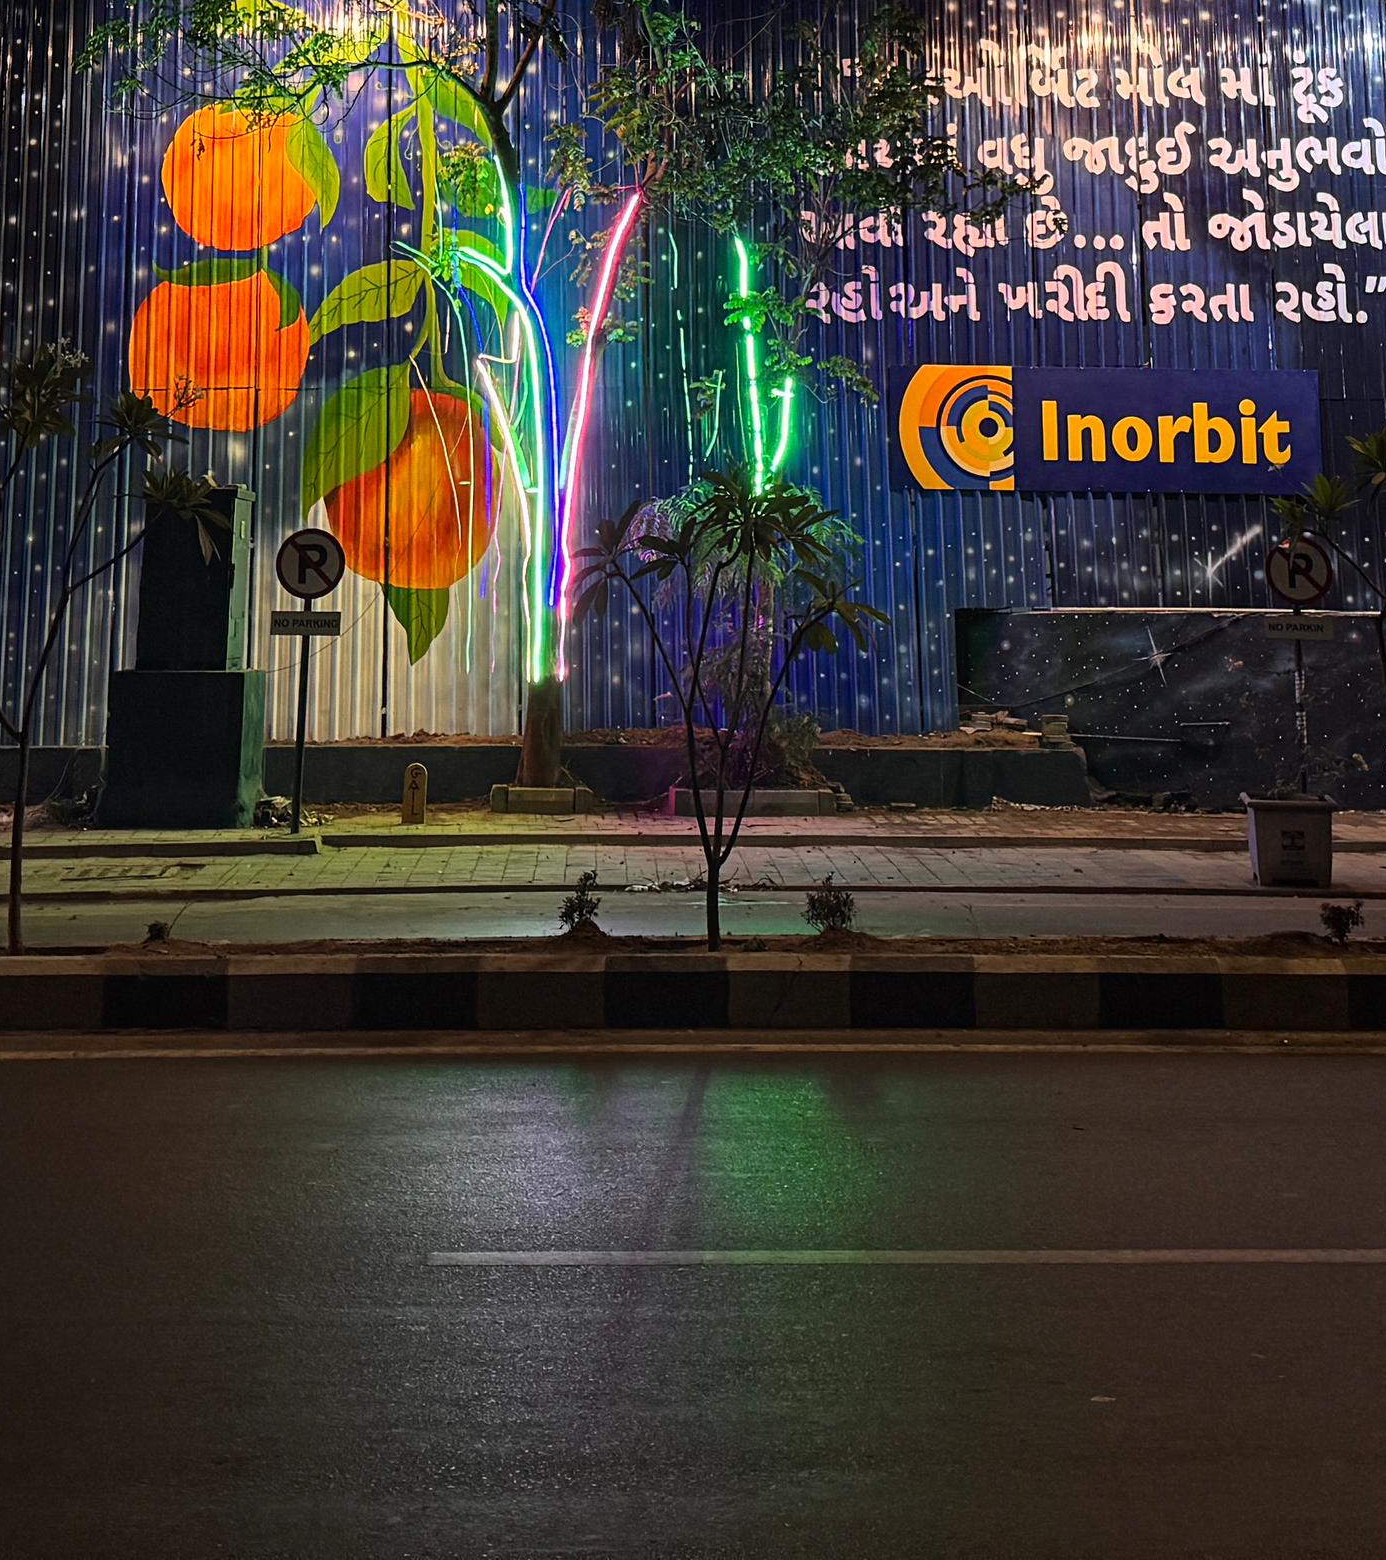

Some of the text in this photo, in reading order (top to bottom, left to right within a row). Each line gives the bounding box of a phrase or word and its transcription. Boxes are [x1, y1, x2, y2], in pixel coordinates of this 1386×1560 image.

[1142, 191, 1191, 251] તો
[888, 267, 981, 323] અને
[998, 260, 1132, 323] ખરીદી
[1148, 282, 1254, 325] કરતા
[1041, 398, 1293, 465] Inorbit
[273, 618, 340, 628] NO PARKING
[1268, 623, 1284, 632] NO
